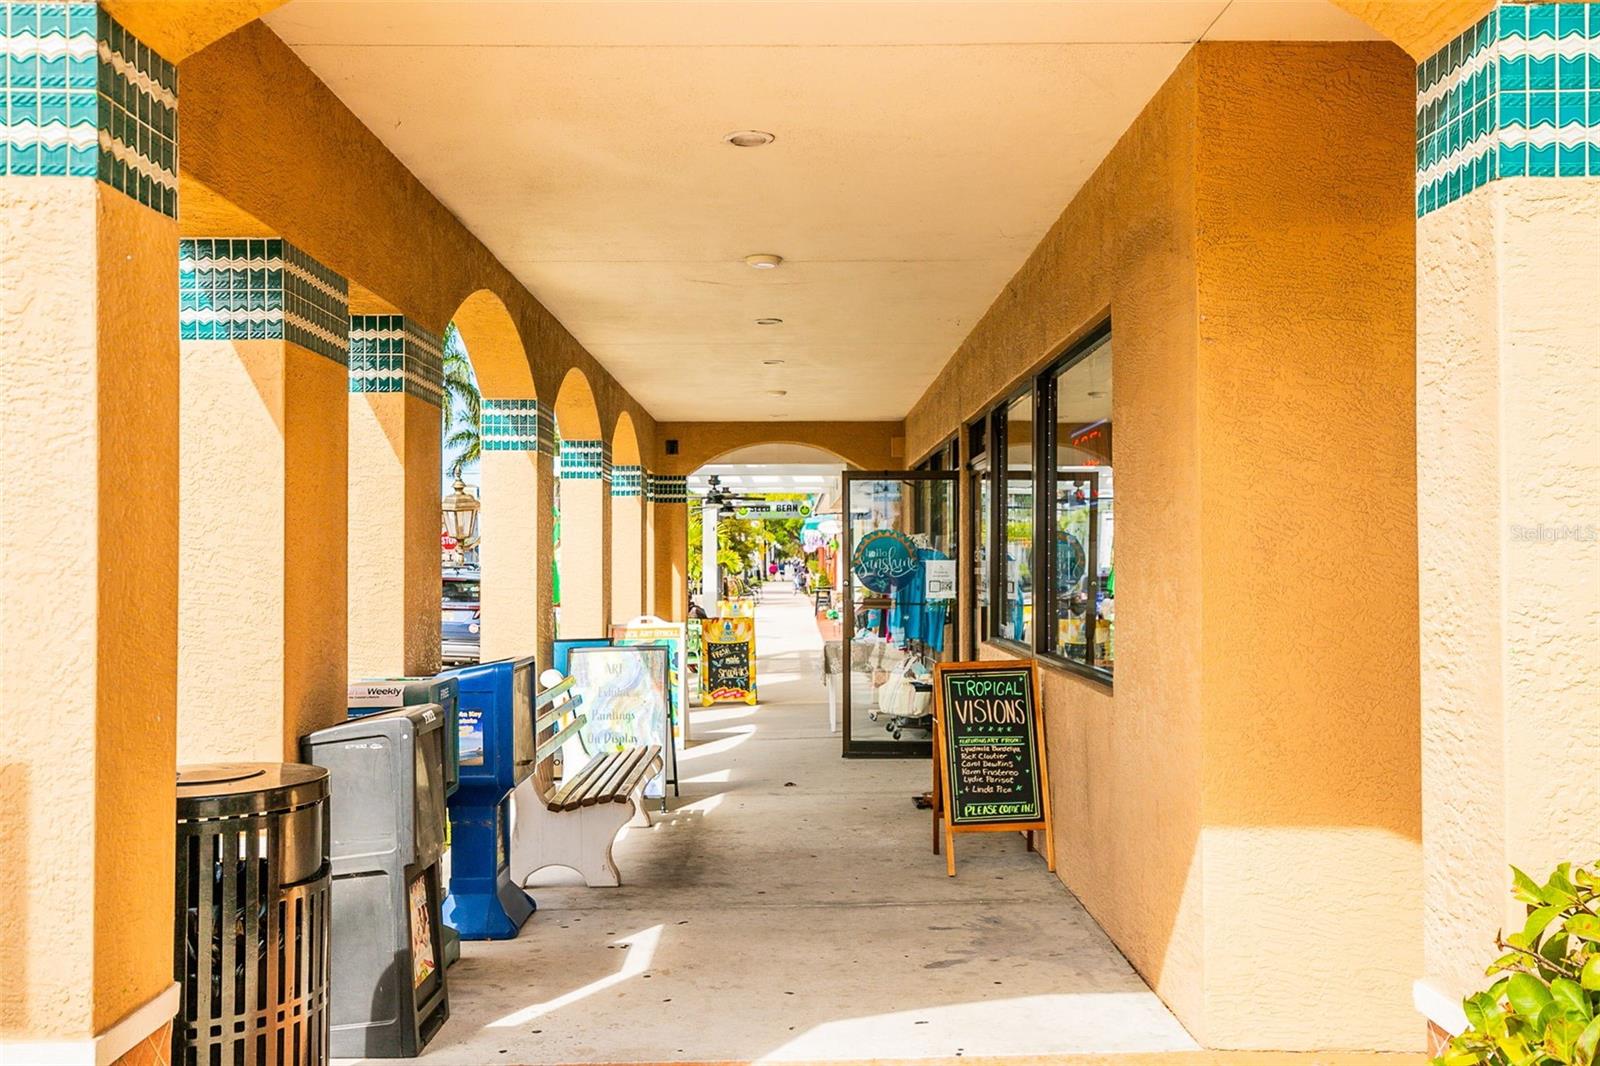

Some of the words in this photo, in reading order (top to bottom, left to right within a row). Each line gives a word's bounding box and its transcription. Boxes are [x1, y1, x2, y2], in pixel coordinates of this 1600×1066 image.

[776, 504, 798, 512] BEAN
[865, 547, 888, 557] hello
[605, 663, 624, 675] ART
[367, 687, 402, 697] Weekly
[952, 680, 1023, 696] TROPICAL
[591, 709, 636, 722] Paintings
[954, 698, 1025, 724] VISIONS
[604, 733, 639, 746] Display
[972, 785, 994, 793] Linda
[964, 804, 998, 817] PLEASE
[998, 804, 1020, 816] COME
